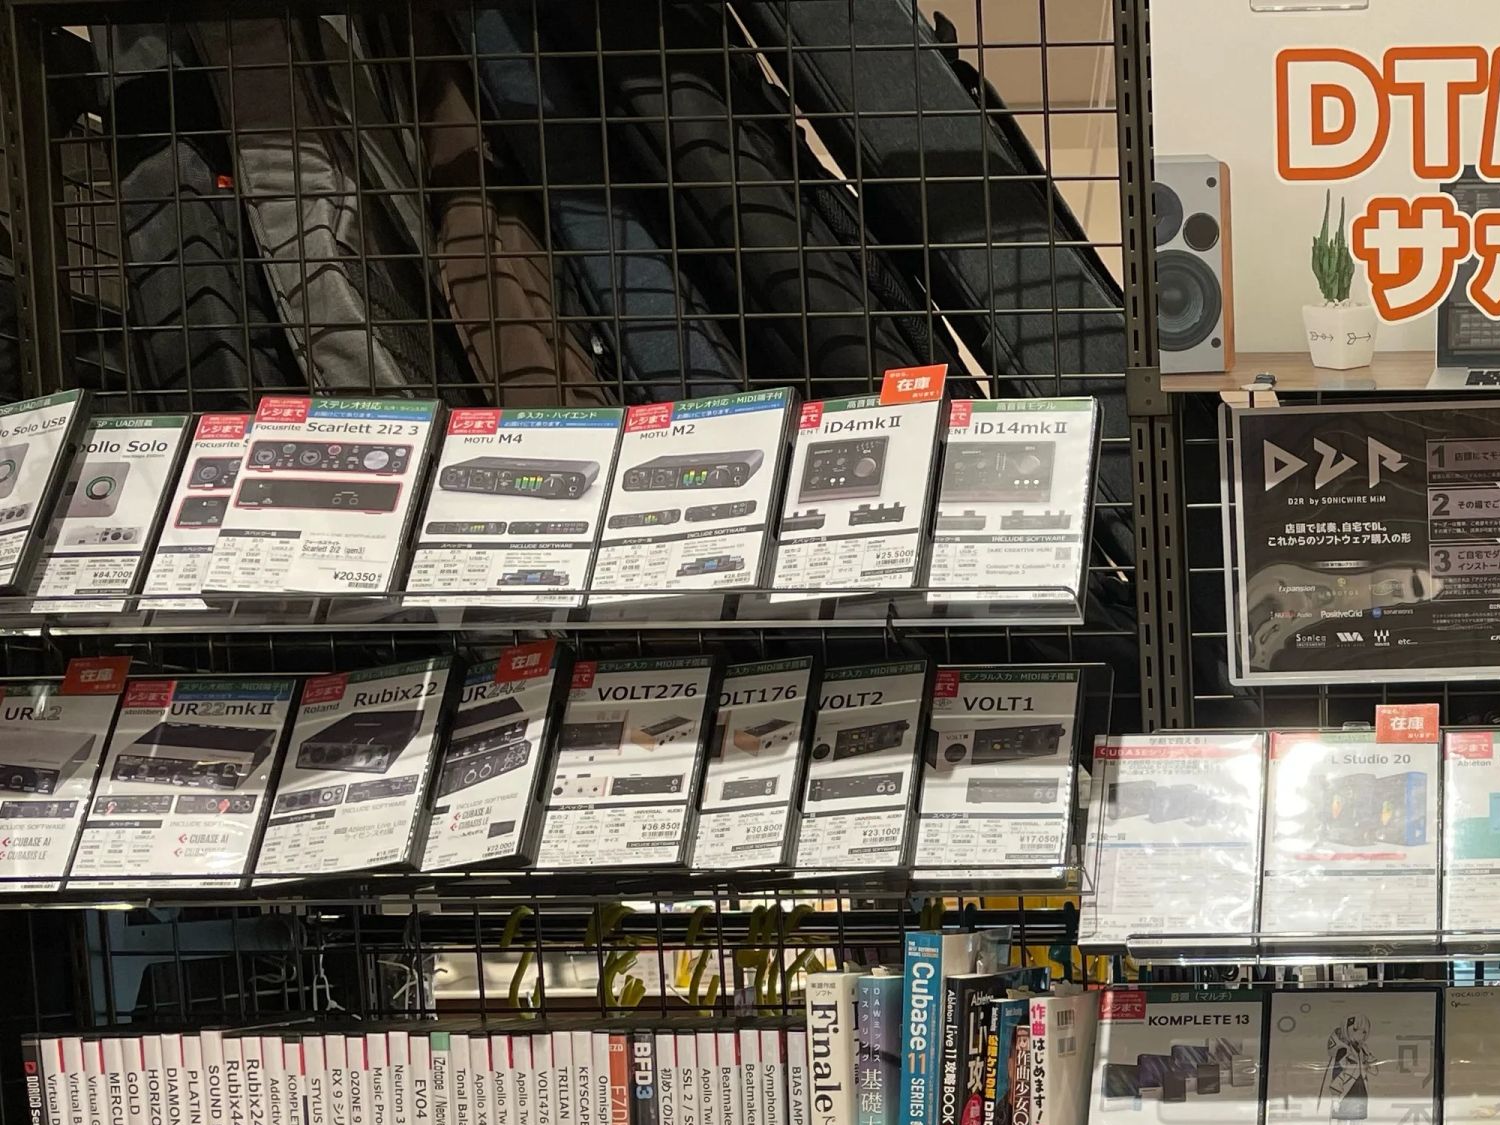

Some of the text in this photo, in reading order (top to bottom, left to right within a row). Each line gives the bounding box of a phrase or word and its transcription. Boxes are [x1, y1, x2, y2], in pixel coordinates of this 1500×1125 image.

[896, 377, 931, 392] 在庫
[307, 421, 372, 434] Scarlett
[377, 423, 403, 434] 2i2
[499, 434, 522, 444] M4
[1322, 496, 1367, 504] SONICWIRE
[334, 572, 376, 582] ¥20,350
[354, 681, 438, 707] Rubix22
[597, 682, 698, 700] VOLT276
[963, 696, 1035, 712] VOLT1
[1344, 754, 1412, 766] Studio 20
[910, 962, 934, 1050] Cubase
[947, 989, 955, 1024] Ableton
[1148, 1014, 1250, 1026] KOMPLETE 13
[946, 1025, 957, 1048] Live
[909, 1052, 926, 1074] 11
[945, 1049, 957, 1060] 11
[633, 1042, 653, 1100] BFD3
[48, 1074, 60, 1116] Virtual
[127, 1072, 140, 1115] GOLD
[208, 1065, 221, 1119] SOUND
[415, 1079, 427, 1119] EVO4
[538, 1071, 549, 1124] VOLT476
[558, 1067, 570, 1119] TRILIAN
[911, 1078, 924, 1117] SERIES
